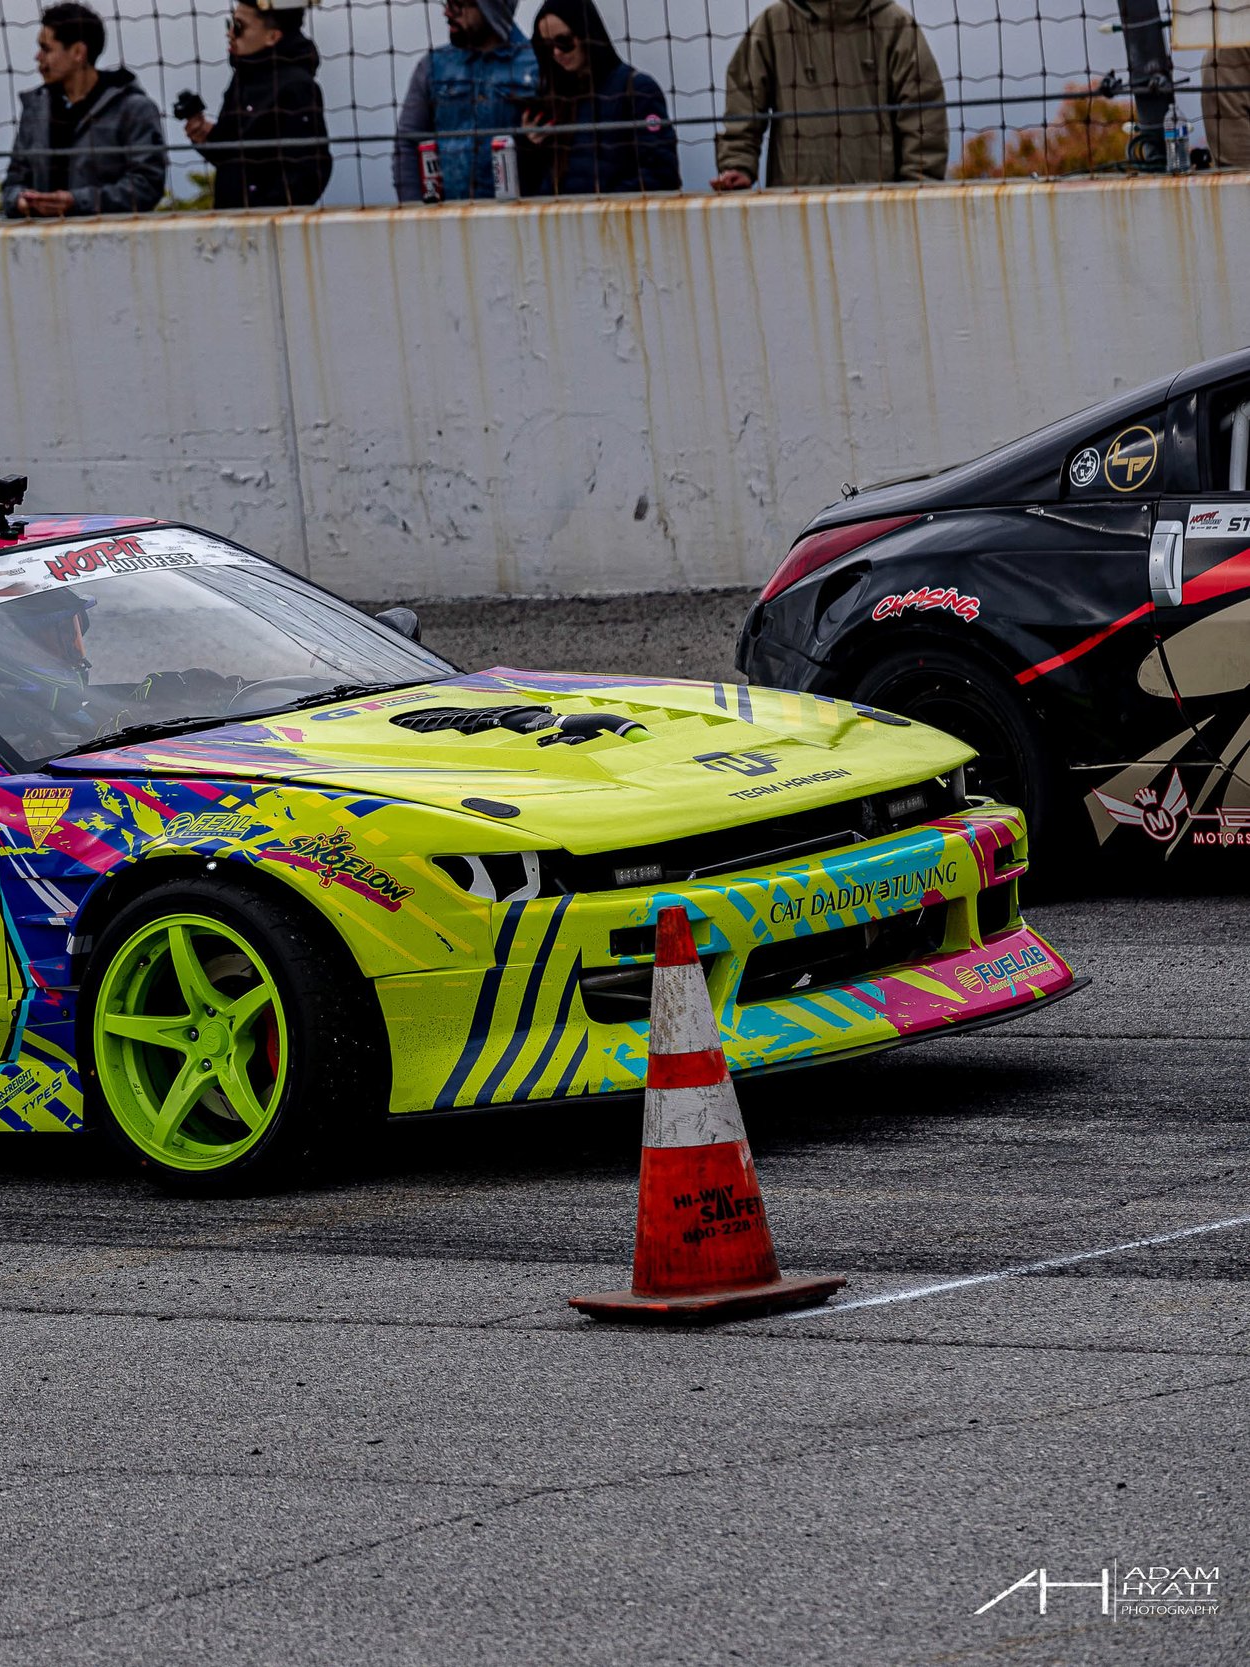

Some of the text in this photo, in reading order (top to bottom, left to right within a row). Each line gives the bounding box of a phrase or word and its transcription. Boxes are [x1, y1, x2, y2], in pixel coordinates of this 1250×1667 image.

[44, 535, 149, 582] HOTPIT
[105, 552, 199, 574] AUTOFEST
[22, 787, 74, 800] LOWEYE
[728, 768, 853, 801] TEAM HANSEN
[190, 812, 251, 832] FEAL
[770, 861, 957, 924] CAT DADDY TUNING
[972, 944, 1048, 985] FUELAB
[4, 1069, 32, 1097] FREIGHT
